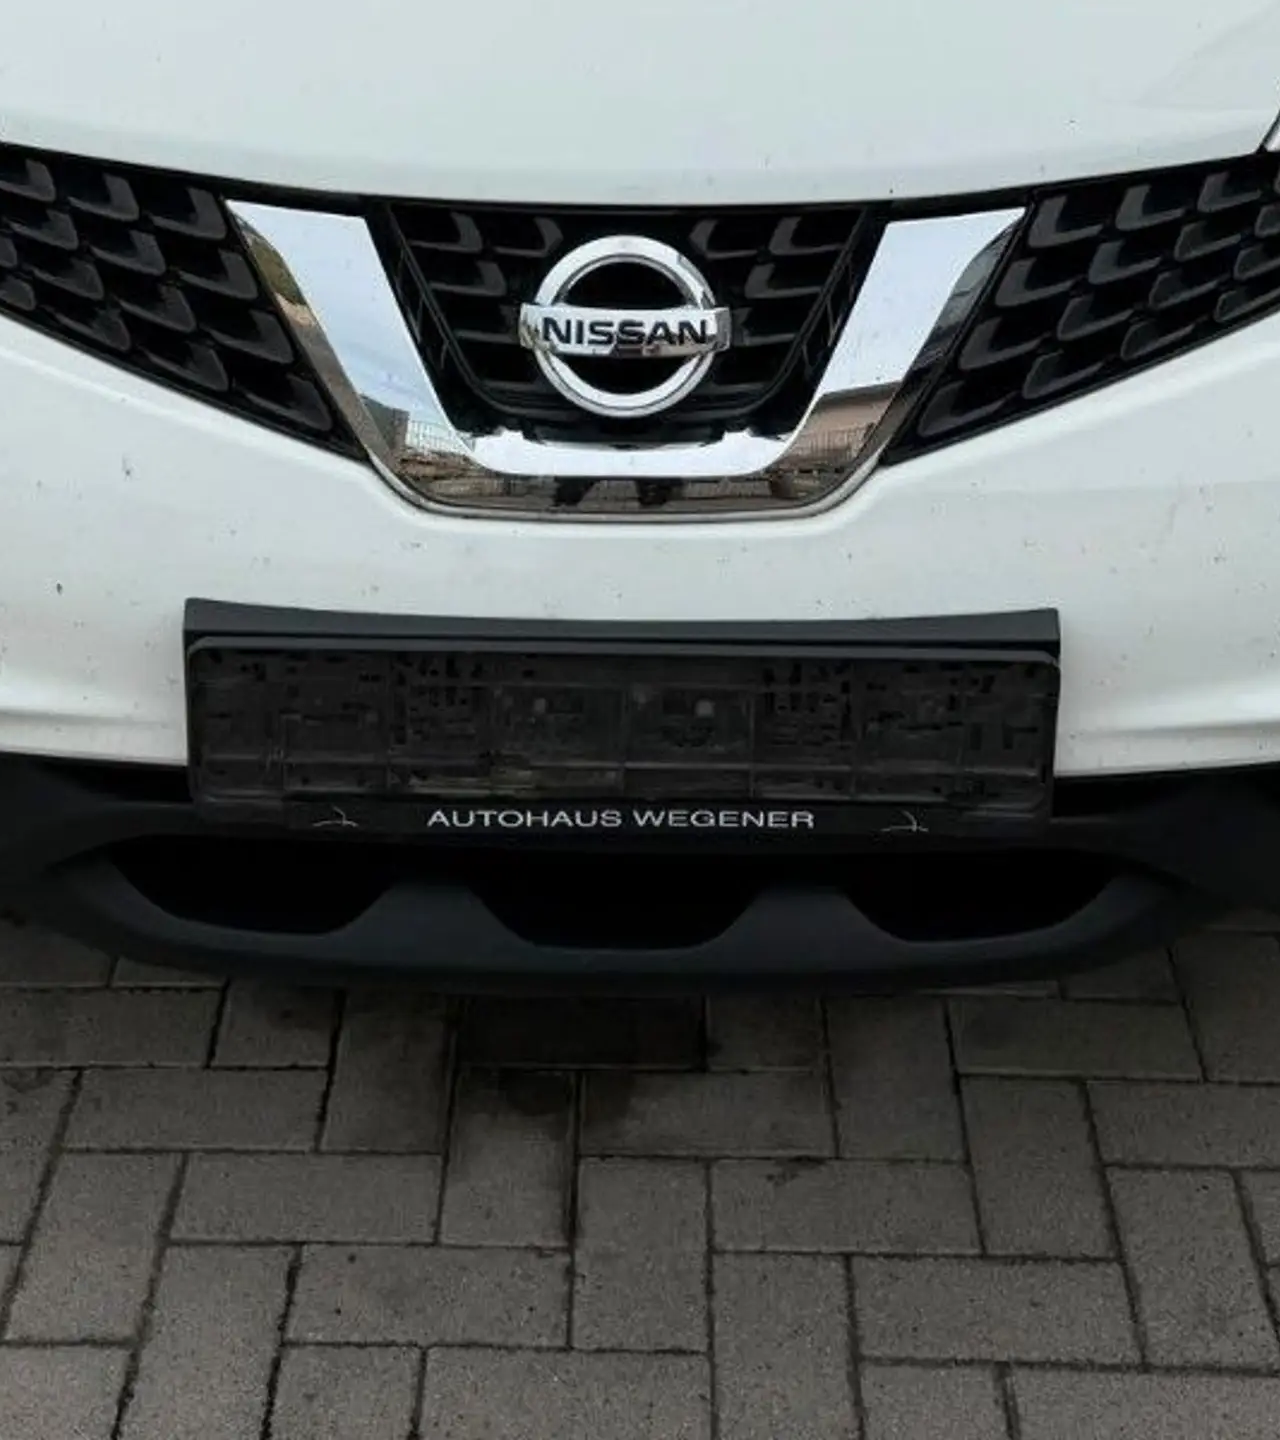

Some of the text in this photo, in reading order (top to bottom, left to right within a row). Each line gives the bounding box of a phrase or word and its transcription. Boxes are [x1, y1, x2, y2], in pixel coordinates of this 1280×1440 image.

[542, 316, 707, 345] NISSAN
[426, 810, 815, 829] AUTOHAUS WEGENER
